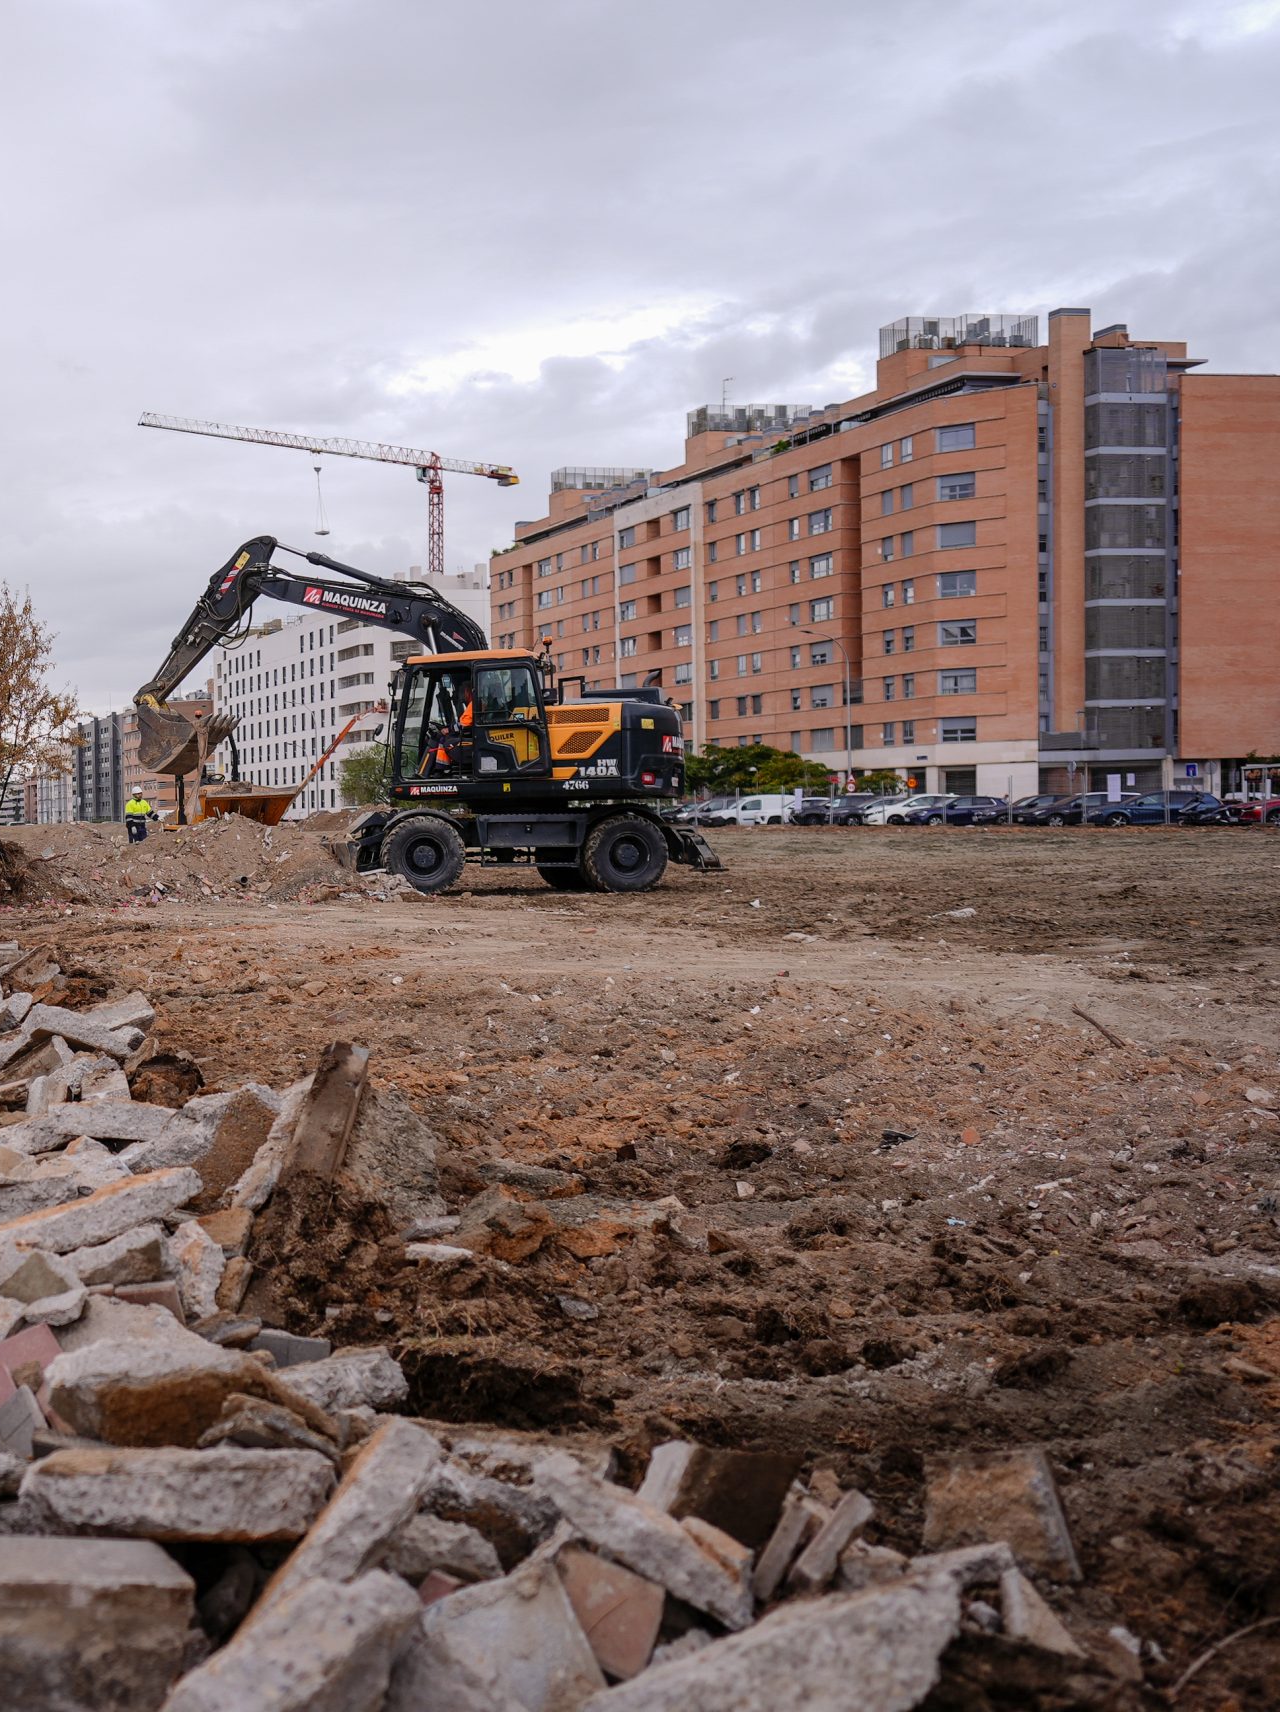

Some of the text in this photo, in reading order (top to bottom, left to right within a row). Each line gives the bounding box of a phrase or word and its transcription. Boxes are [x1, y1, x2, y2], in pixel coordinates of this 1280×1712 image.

[323, 591, 386, 614] MAQUINZA
[597, 759, 617, 767] HW
[579, 767, 618, 777] 140A
[562, 780, 590, 790] 4766
